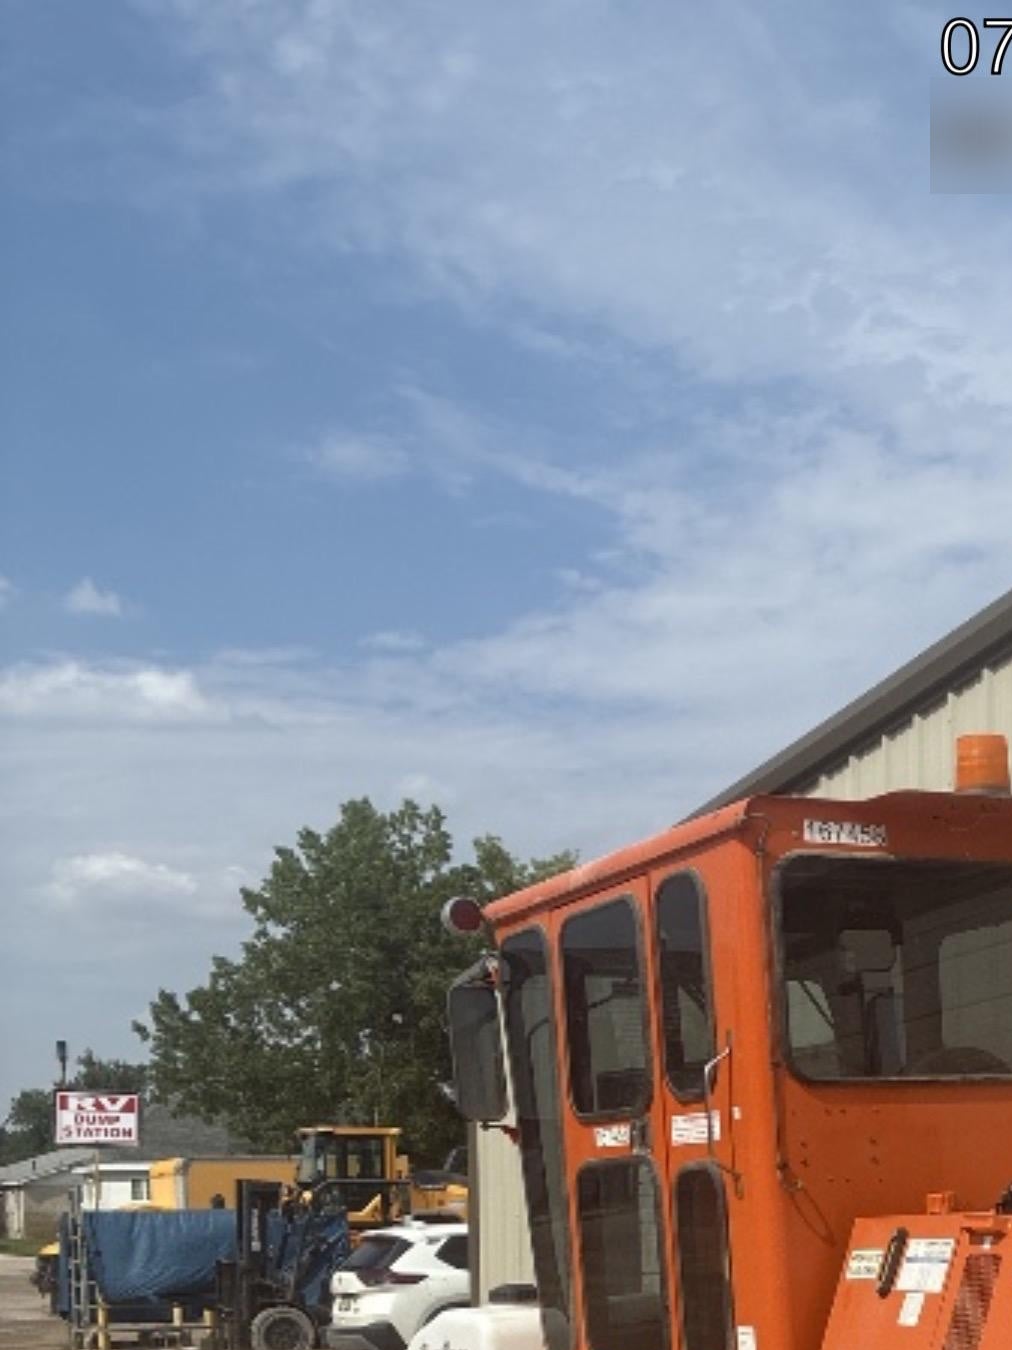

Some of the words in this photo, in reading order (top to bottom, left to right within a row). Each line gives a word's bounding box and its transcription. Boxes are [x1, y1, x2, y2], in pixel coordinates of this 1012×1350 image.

[67, 1094, 130, 1111] RV
[74, 1113, 120, 1125] DUMP
[62, 1125, 132, 1138] STATION
